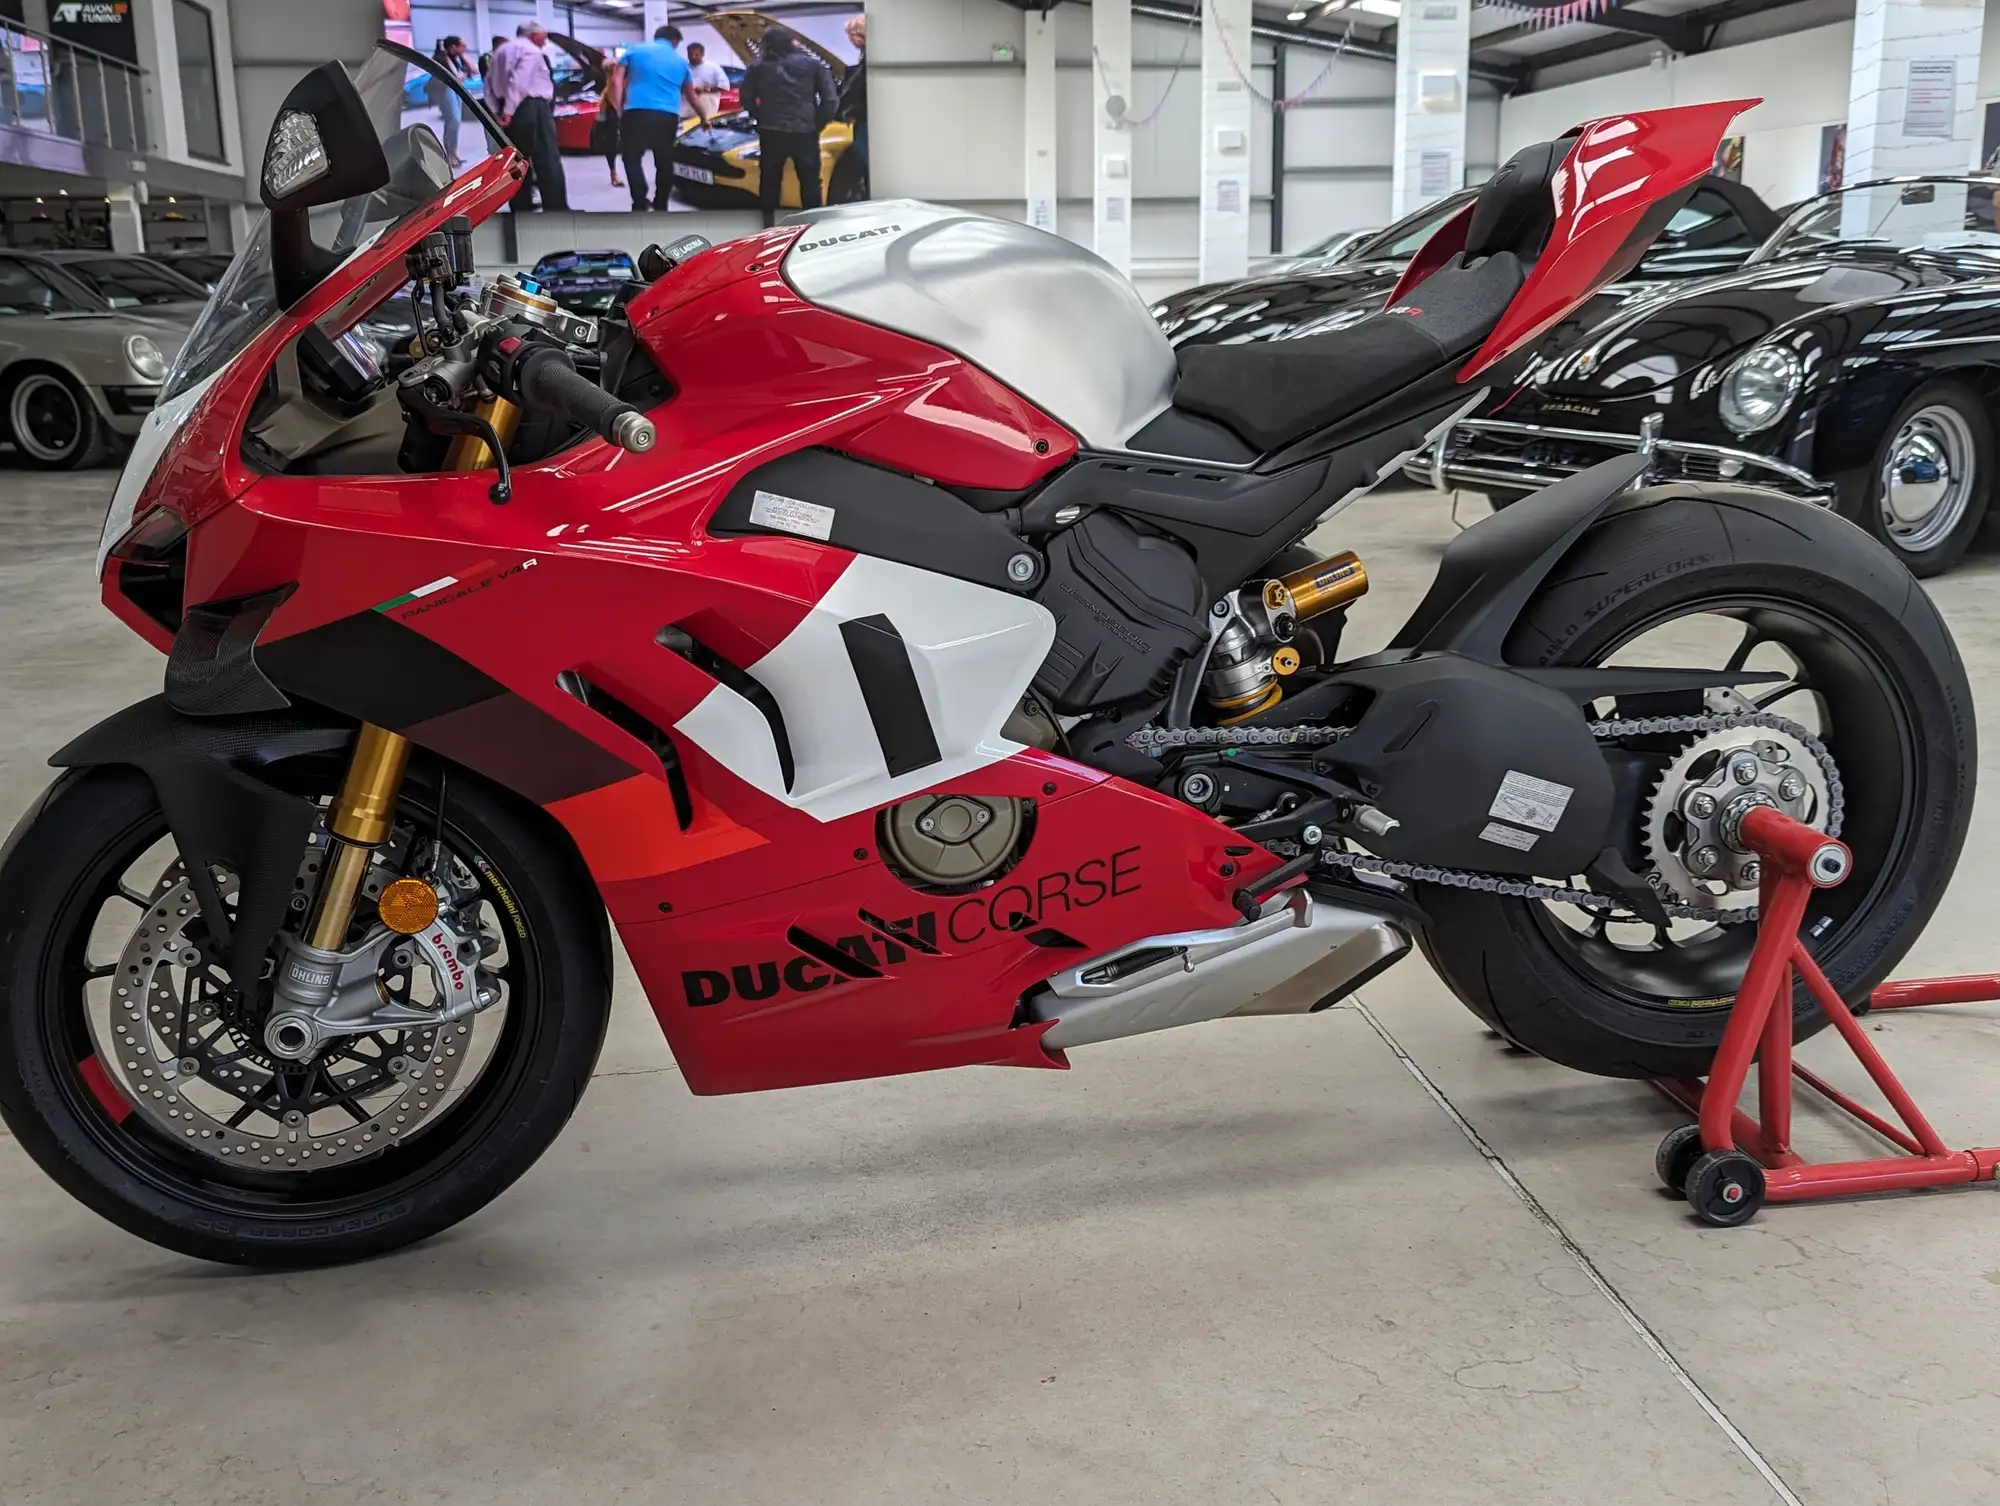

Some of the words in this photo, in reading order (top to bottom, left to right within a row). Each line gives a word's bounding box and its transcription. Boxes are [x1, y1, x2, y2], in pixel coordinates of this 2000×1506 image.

[82, 13, 122, 23] TUNING
[83, 4, 113, 14] AVON
[799, 225, 901, 253] DUCATI
[402, 578, 493, 619] PANIGALE
[498, 558, 538, 580] V4R
[484, 870, 519, 914] marchesini
[681, 911, 937, 1008] DUCATI
[948, 846, 1141, 944] CORSE
[292, 964, 331, 986] ÖHLINS
[432, 933, 464, 990] brembo
